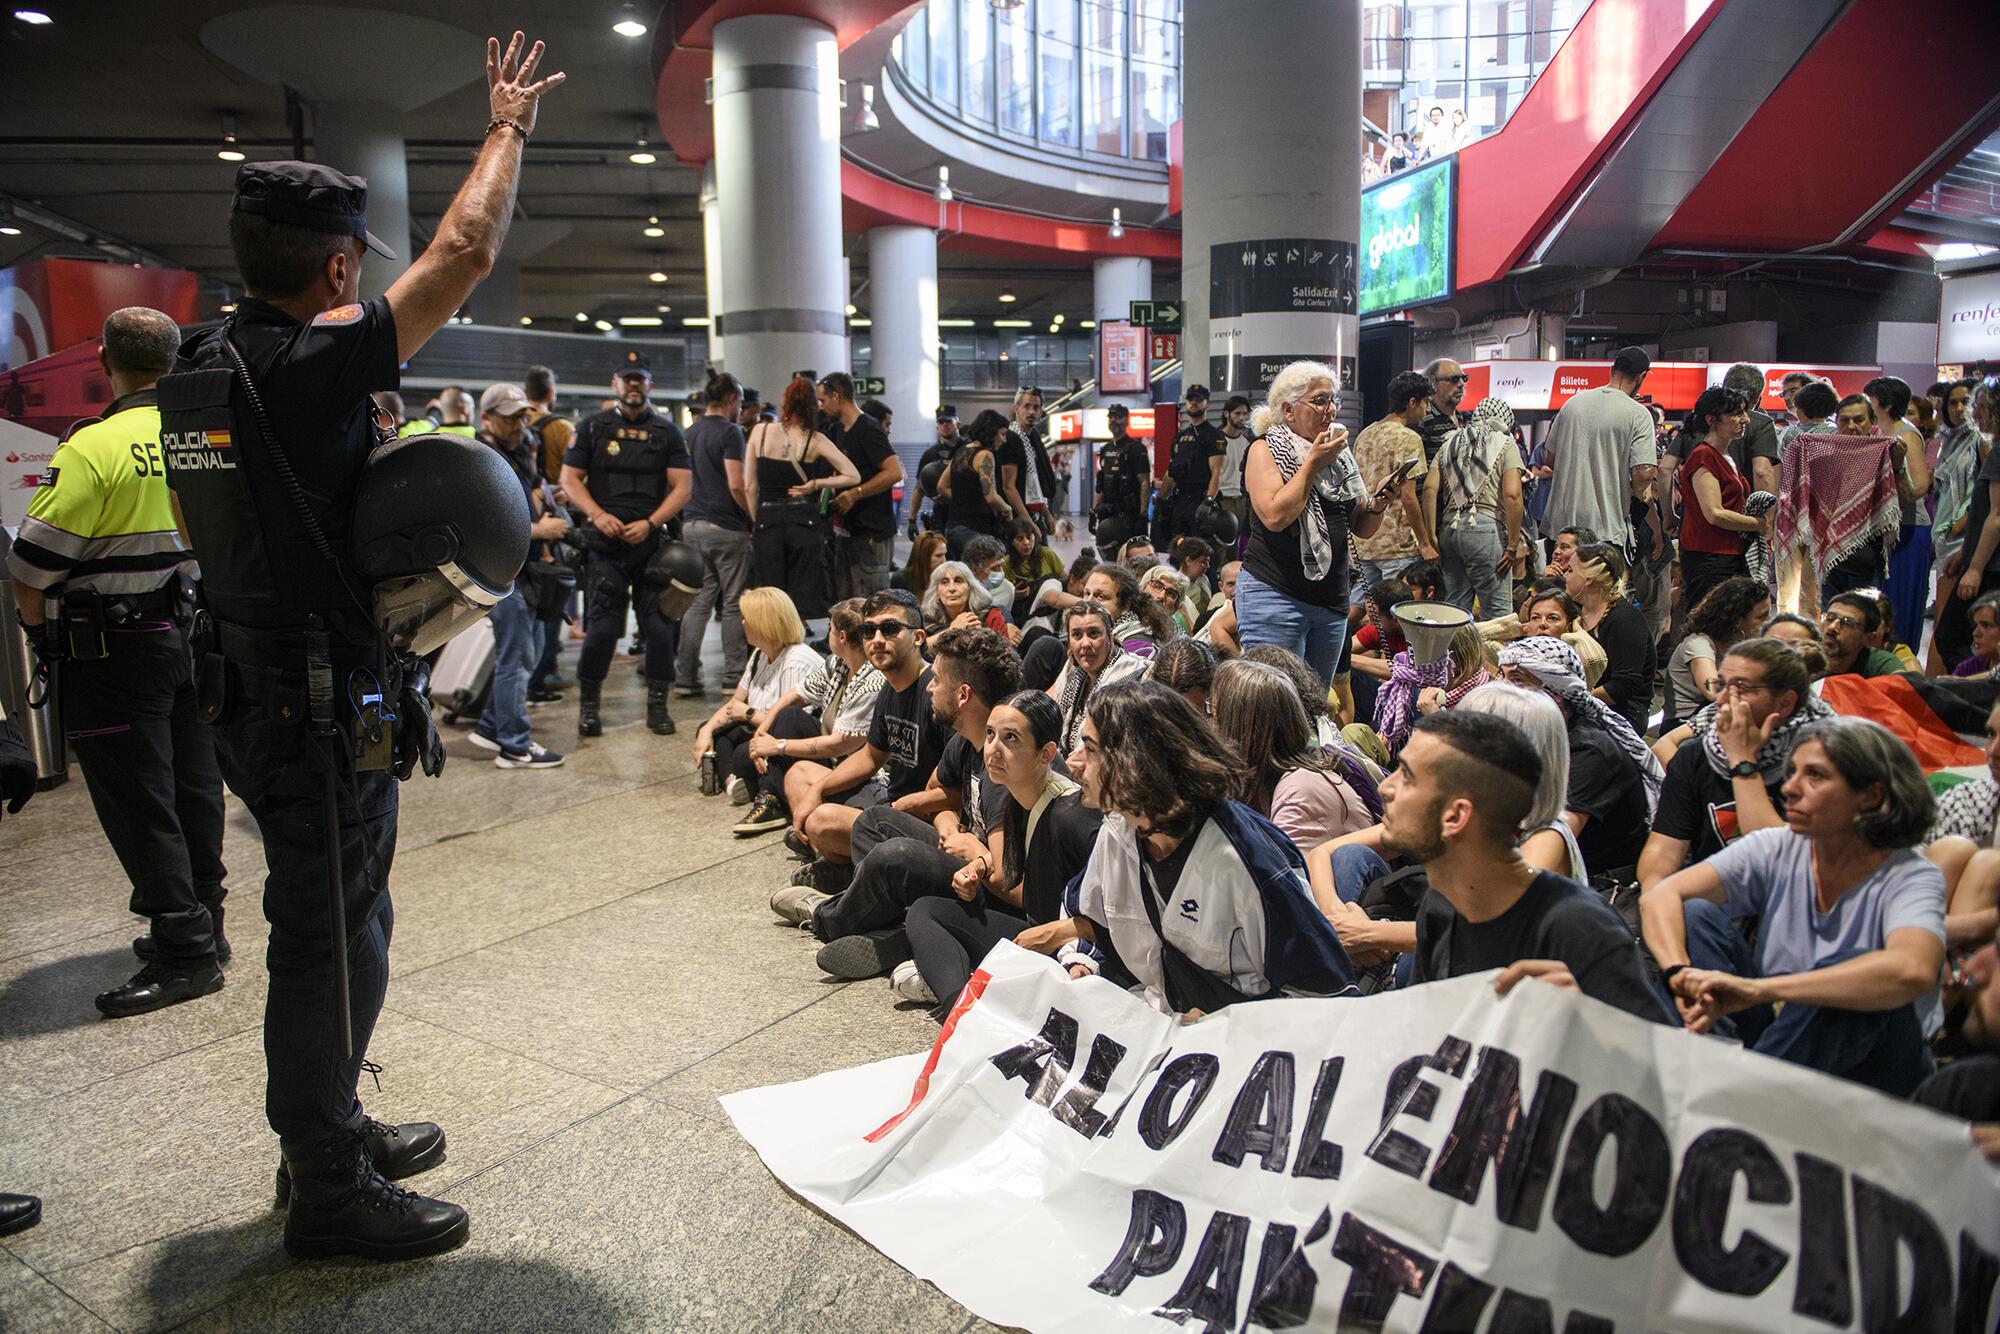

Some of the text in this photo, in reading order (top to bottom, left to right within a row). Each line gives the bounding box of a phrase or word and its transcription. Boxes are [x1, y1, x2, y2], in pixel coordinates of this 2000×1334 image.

[1369, 212, 1420, 270] global
[1292, 286, 1339, 299] Salida/Exit
[1986, 323, 2000, 337] Ce
[1260, 362, 1284, 373] Puer
[1496, 375, 1525, 389] renfe
[1560, 376, 1589, 386] Billetes
[20, 451, 53, 463] Santa
[130, 442, 163, 478] SE
[1212, 1050, 1345, 1181] AL
